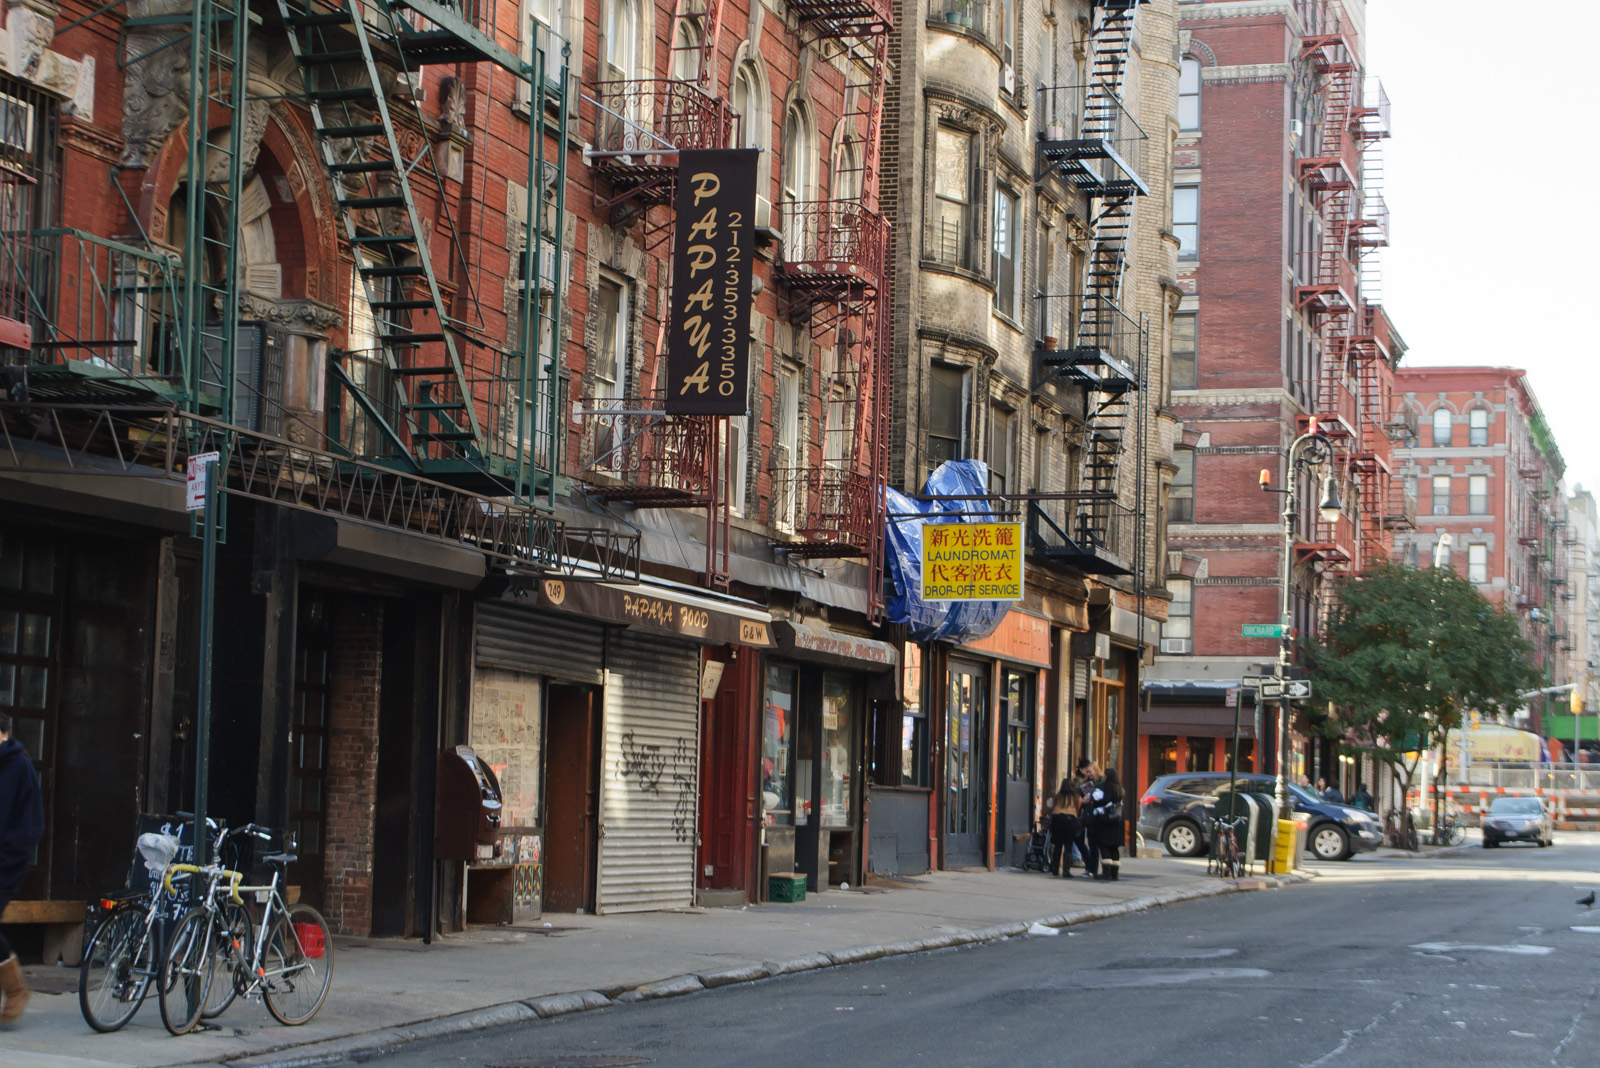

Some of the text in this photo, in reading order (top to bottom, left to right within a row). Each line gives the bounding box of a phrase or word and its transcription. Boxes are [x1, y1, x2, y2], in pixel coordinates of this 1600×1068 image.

[680, 172, 721, 396] PAPAYA
[928, 550, 1016, 561] LAUNDROMAT
[930, 563, 1013, 583] 代客洗衣
[924, 584, 1019, 596] DROP-OFF SERVICE
[623, 594, 709, 629] PAPAYA FOOD
[1244, 625, 1274, 635] ORCHARD
